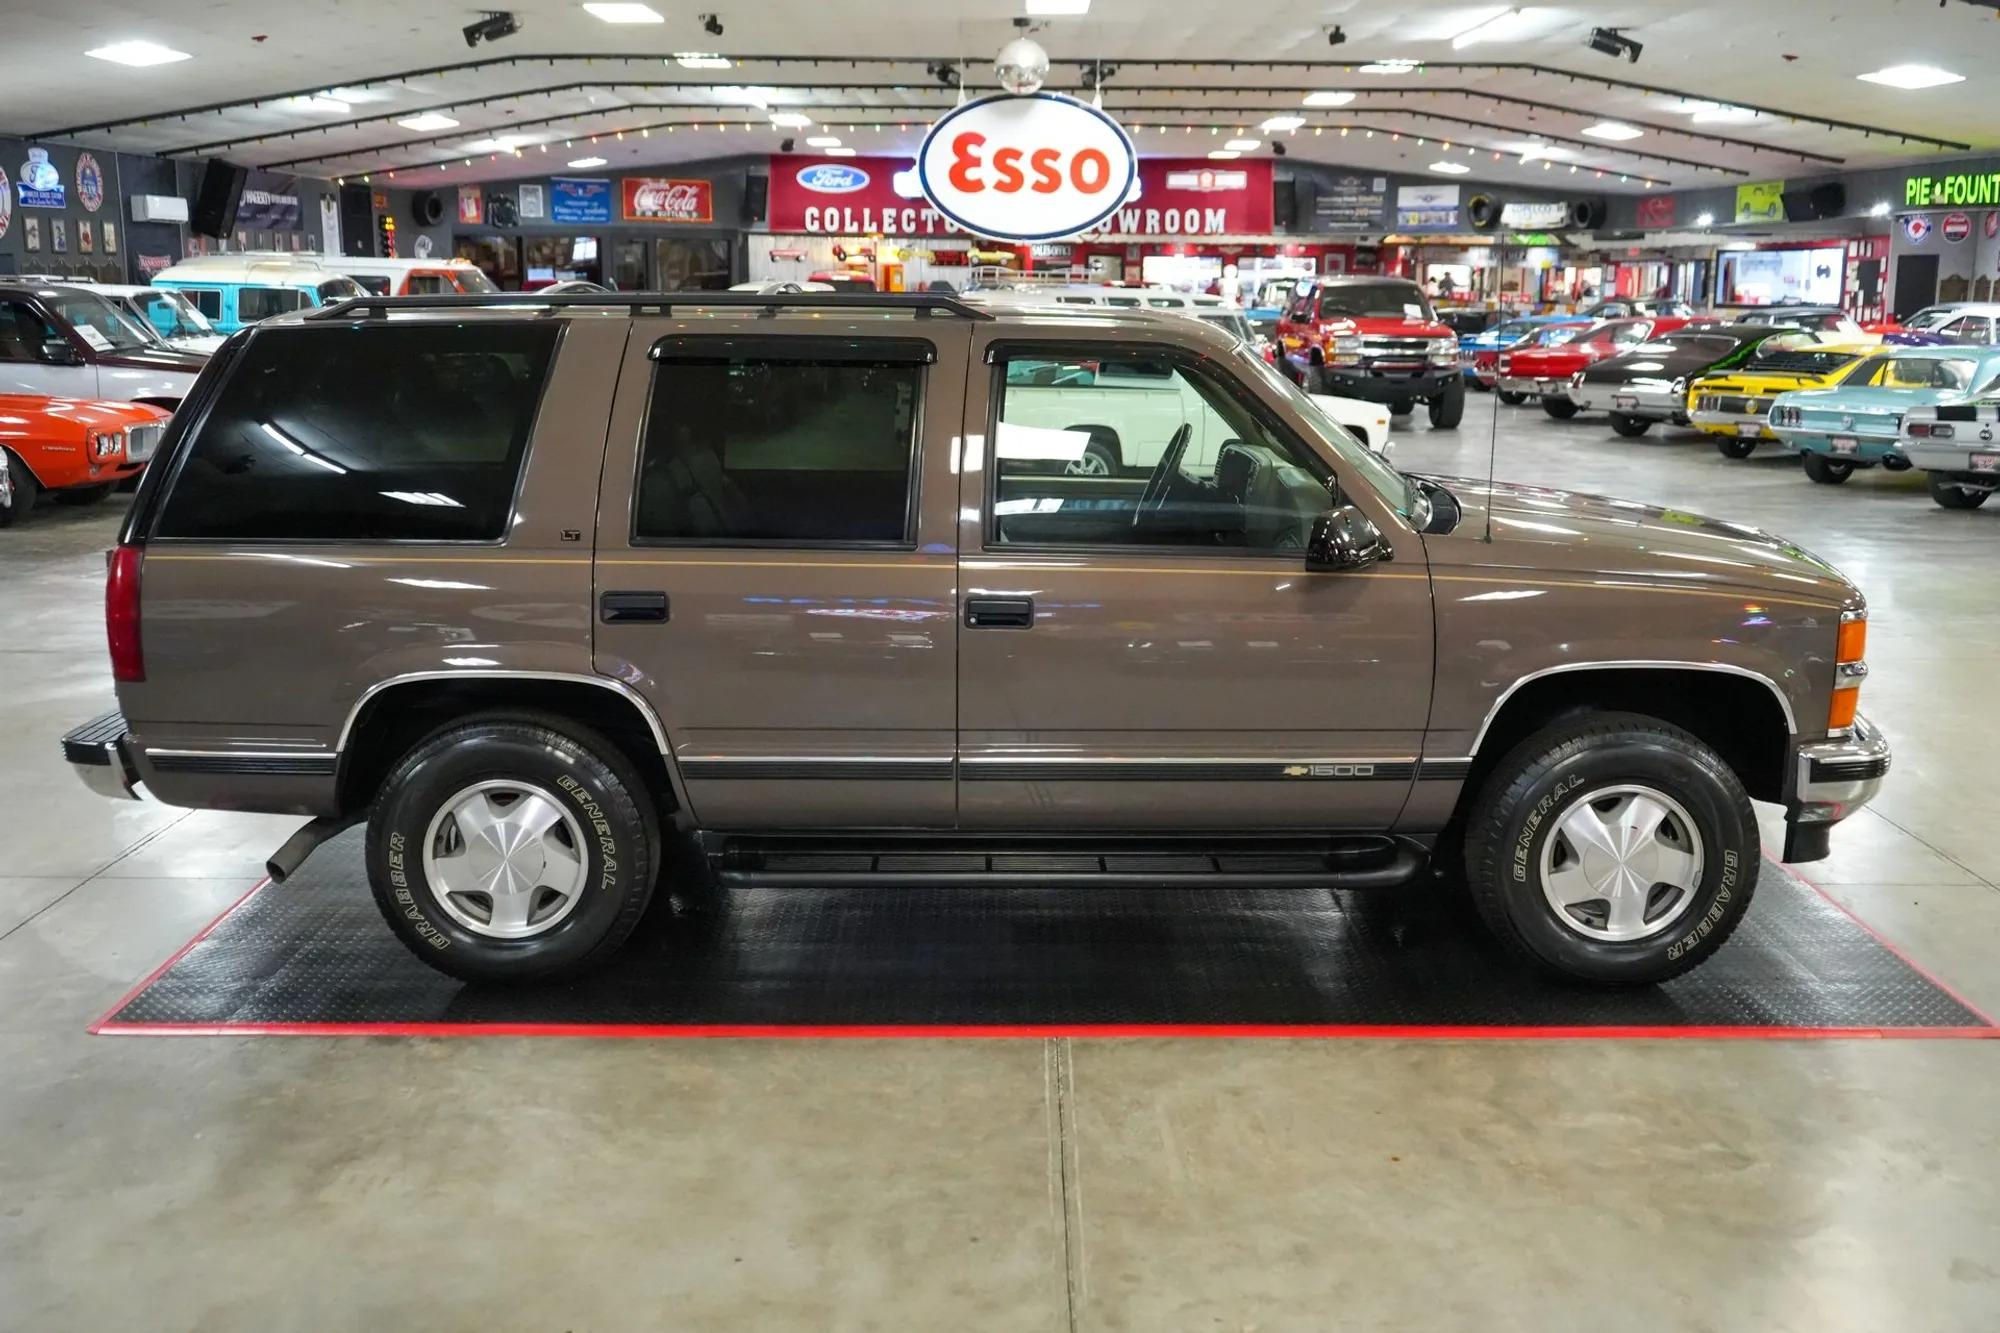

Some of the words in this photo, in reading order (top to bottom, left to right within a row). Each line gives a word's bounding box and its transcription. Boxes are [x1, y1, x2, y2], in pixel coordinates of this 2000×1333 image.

[812, 168, 853, 187] Ford
[1905, 177, 1931, 206] PIE
[1943, 174, 2000, 205] FOUNT
[1096, 207, 1226, 234] OWROOM
[1309, 764, 1374, 776] 1500
[557, 775, 618, 890] GENERAL
[1512, 773, 1586, 883] GENERAL
[388, 831, 450, 950] GRABBER
[1666, 849, 1739, 960] GRABBER
